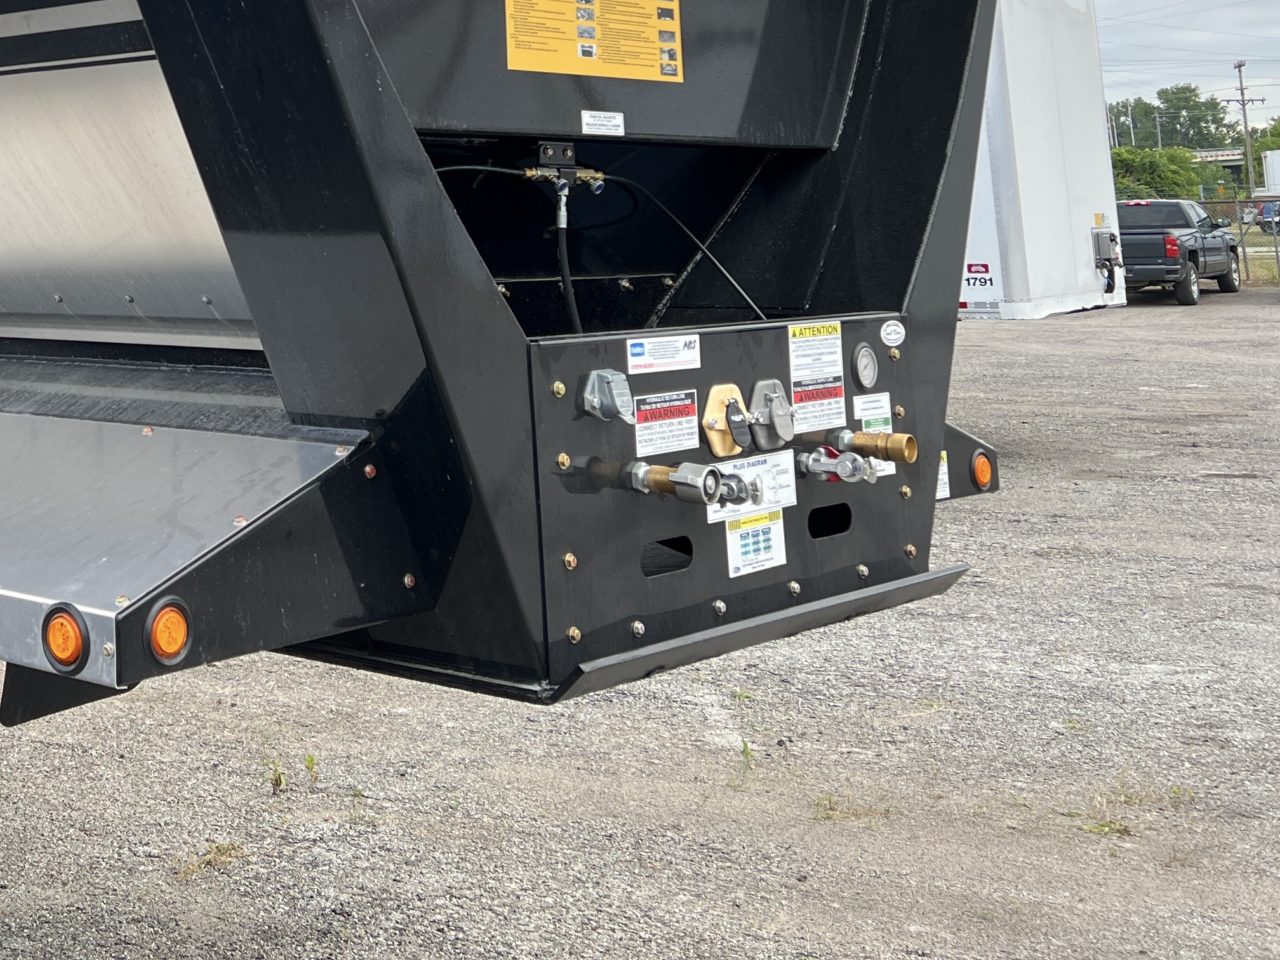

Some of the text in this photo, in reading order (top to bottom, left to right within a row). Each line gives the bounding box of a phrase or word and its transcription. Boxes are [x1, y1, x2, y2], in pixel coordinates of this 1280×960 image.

[964, 276, 993, 287] 1791
[799, 325, 838, 338] ATTENTION
[803, 388, 838, 401] WARNING
[649, 406, 691, 420] WARNING
[733, 459, 768, 471] PLUG DIAGRAM
